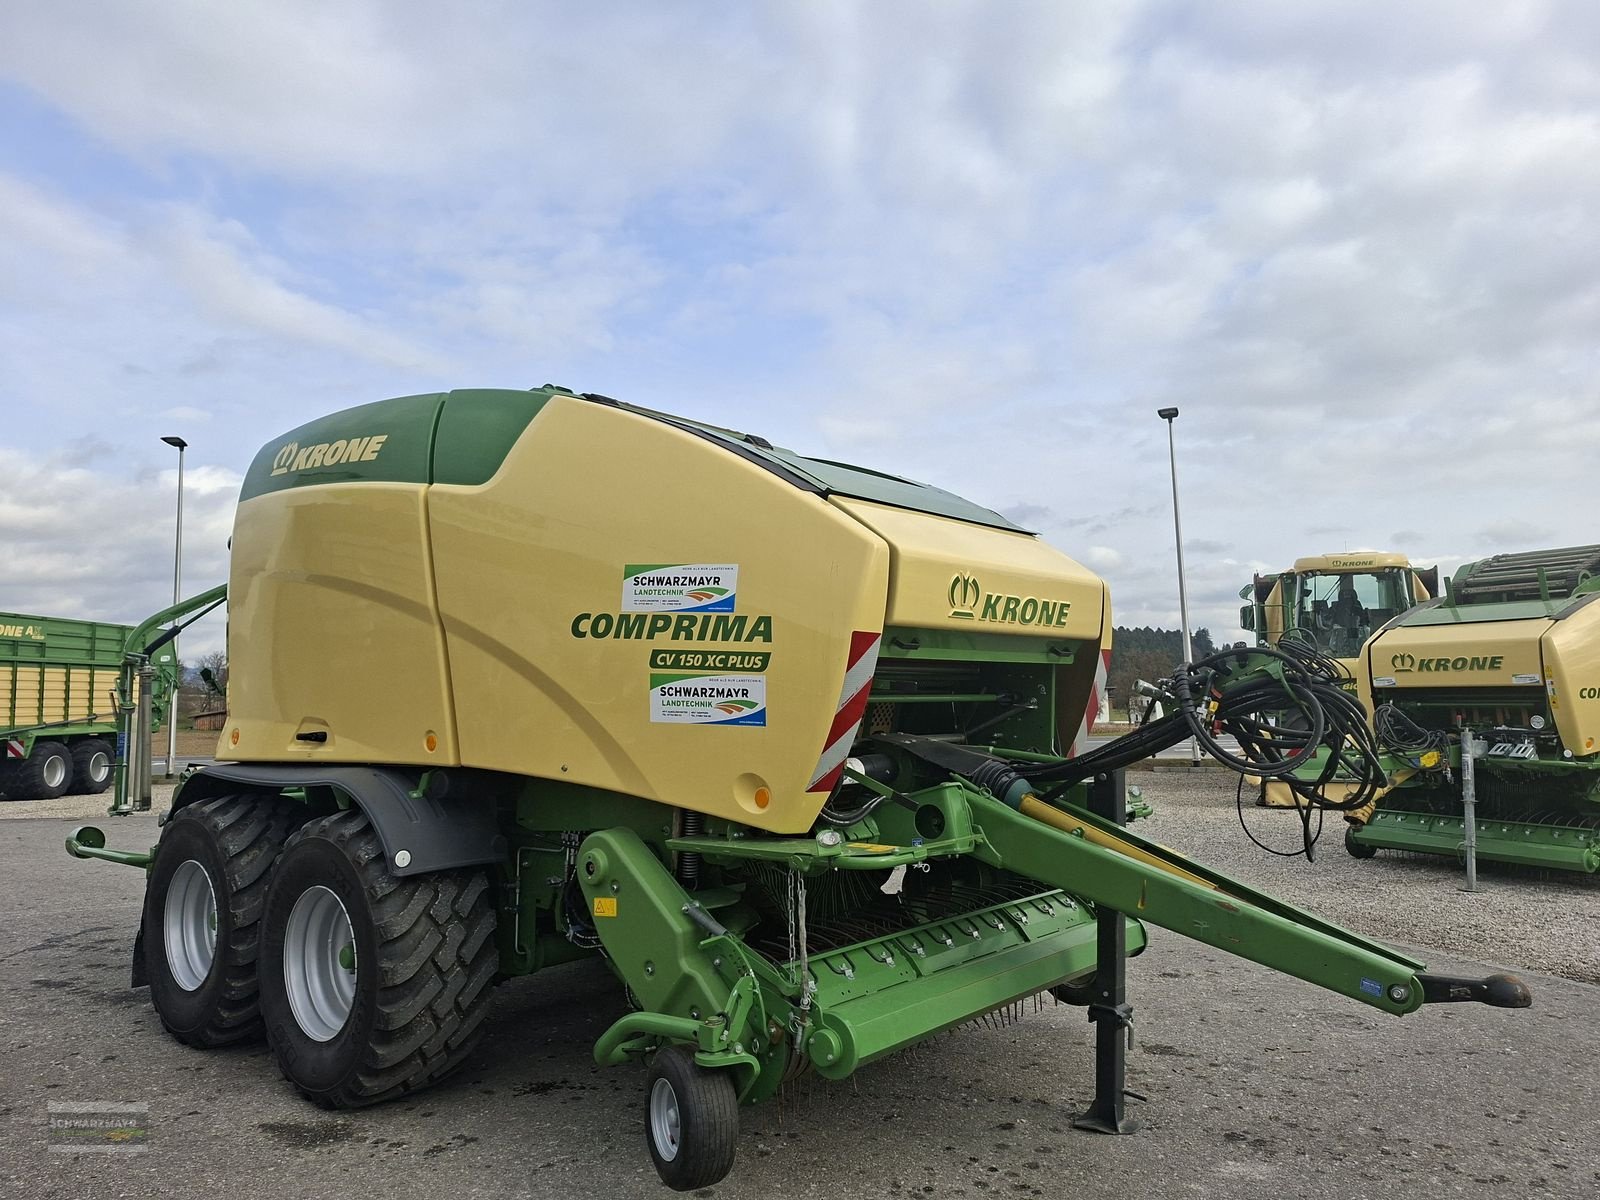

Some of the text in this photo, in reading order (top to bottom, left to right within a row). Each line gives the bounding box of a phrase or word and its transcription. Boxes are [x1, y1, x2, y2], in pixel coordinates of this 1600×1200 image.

[289, 434, 389, 472] KRONE
[633, 576, 721, 587] SCHWARZMAYR
[979, 592, 1071, 628] KRONE
[571, 613, 772, 643] COMPRIMA
[656, 653, 763, 669] CV 150 XC PLUS
[1417, 655, 1505, 673] KRONE
[660, 686, 749, 698] SCHWARZMAYR
[1579, 687, 1600, 699] CO
[661, 700, 713, 708] LANDTECHNIK
